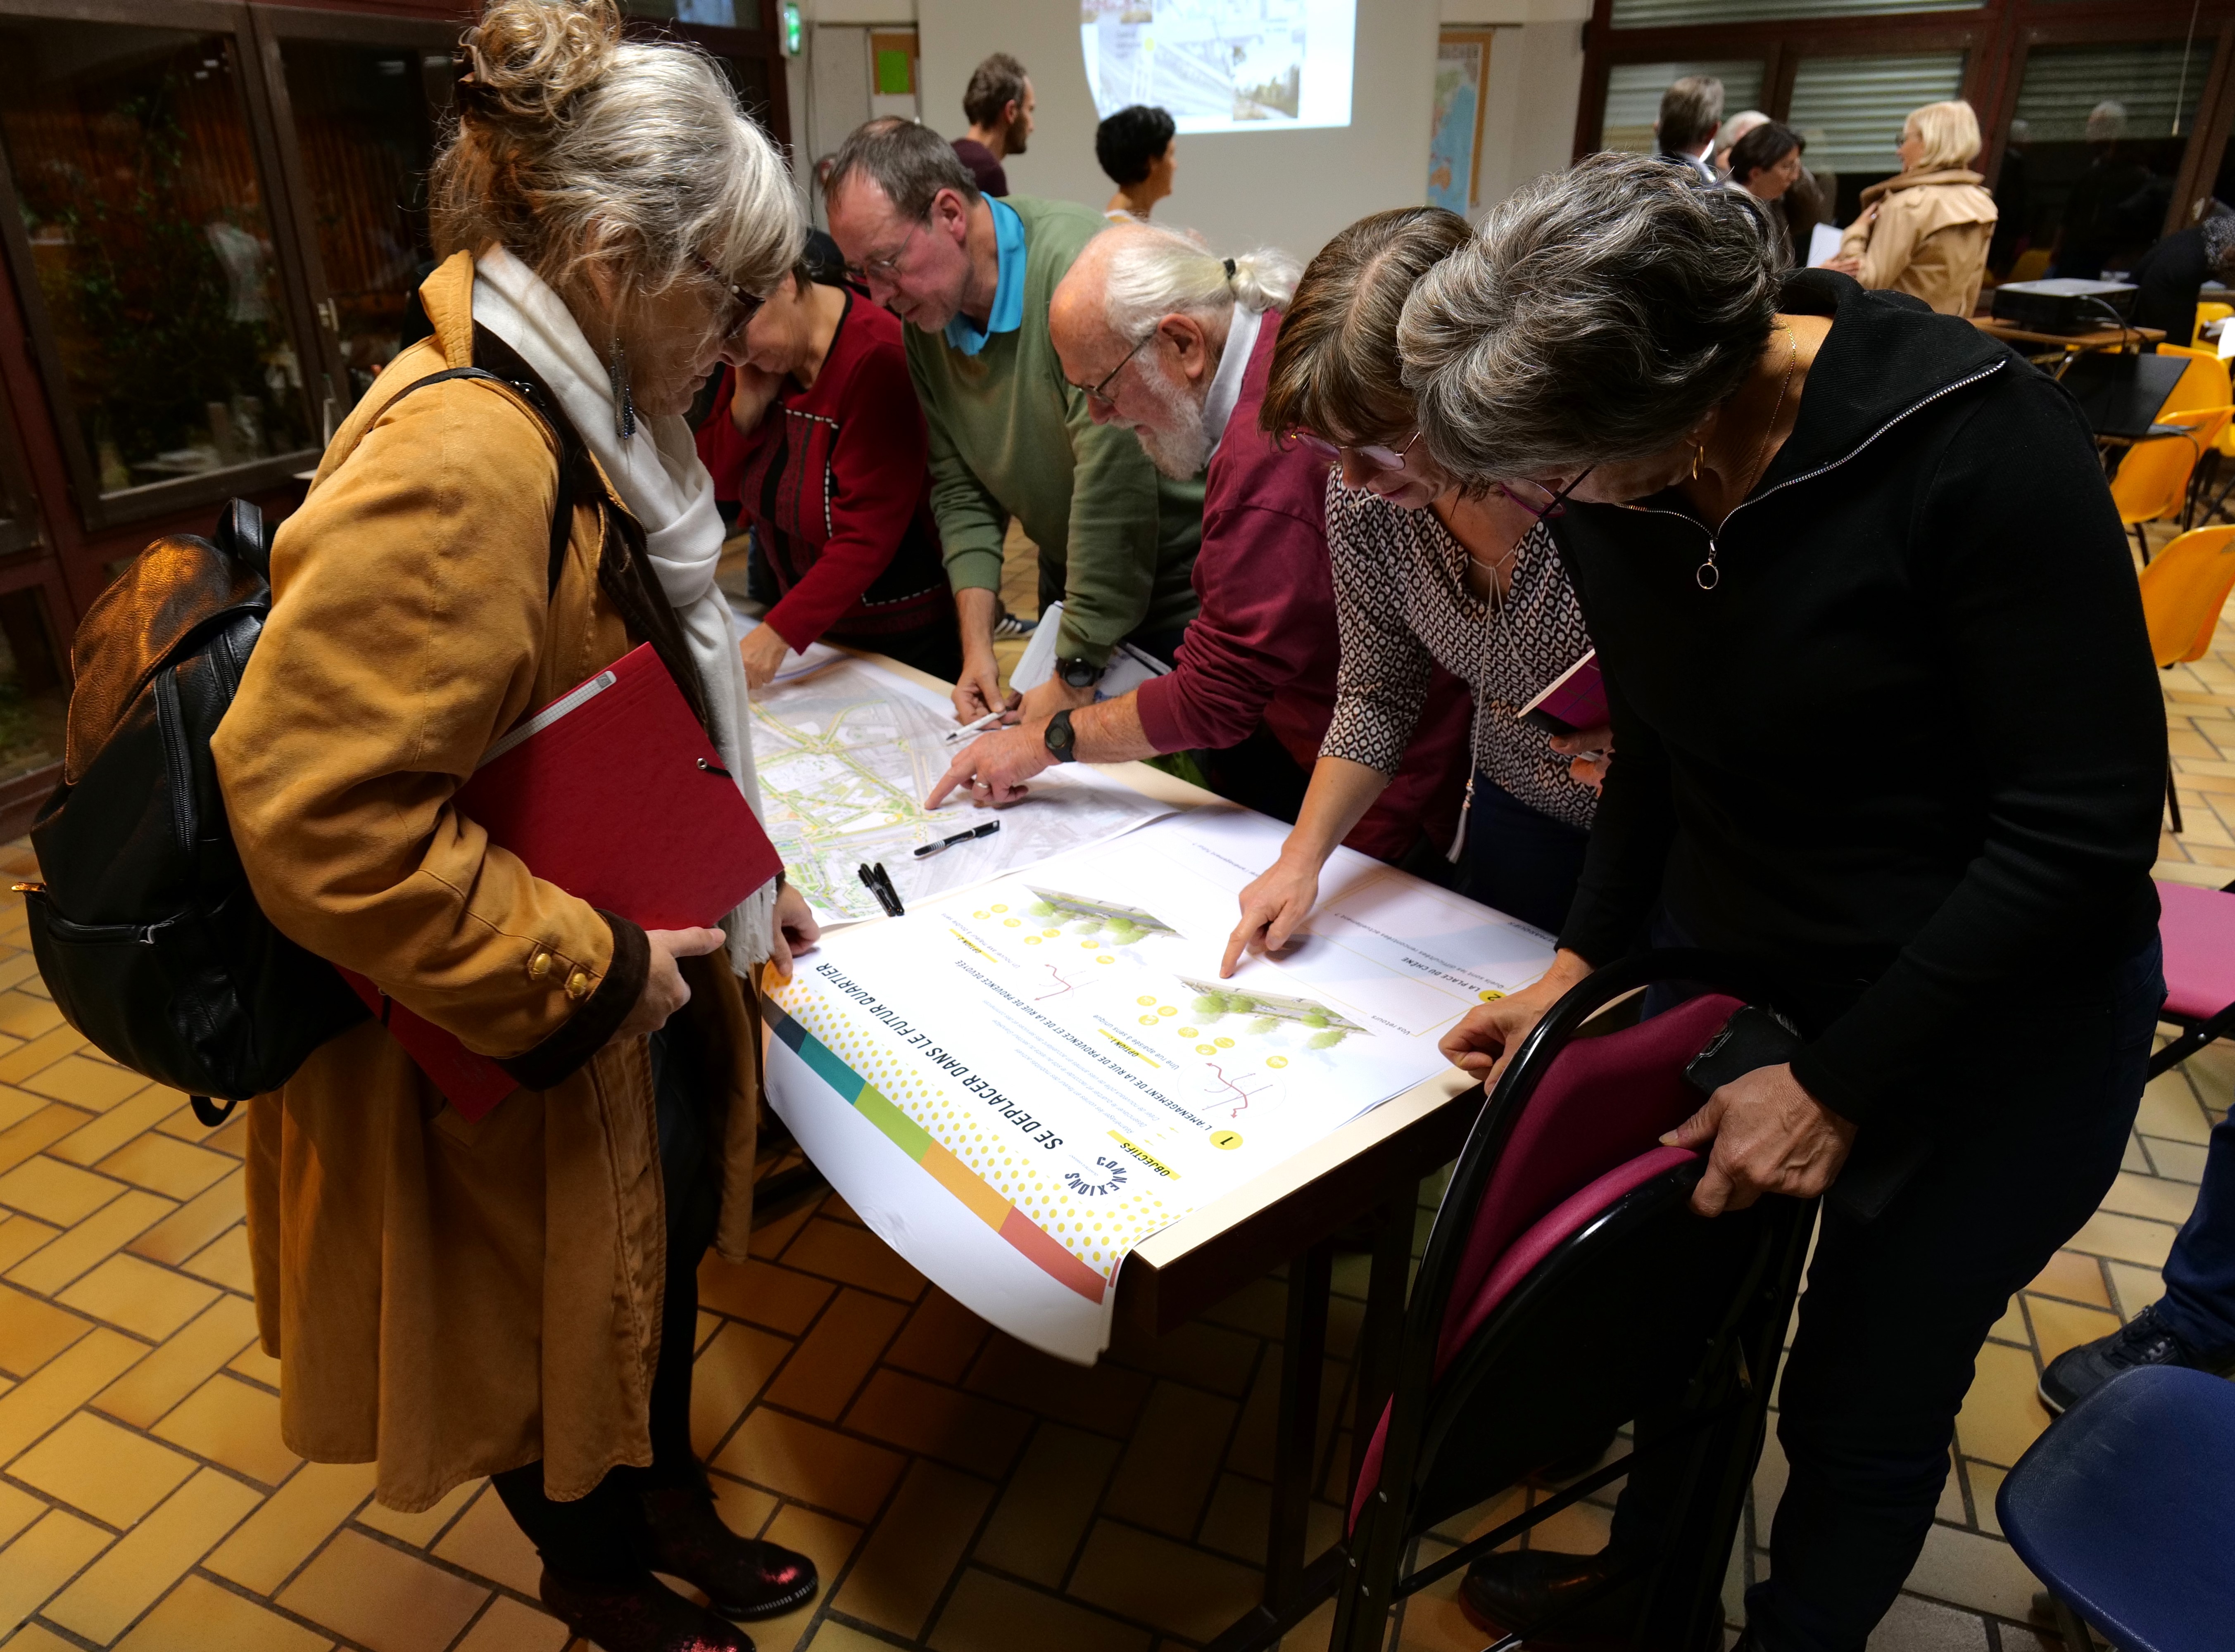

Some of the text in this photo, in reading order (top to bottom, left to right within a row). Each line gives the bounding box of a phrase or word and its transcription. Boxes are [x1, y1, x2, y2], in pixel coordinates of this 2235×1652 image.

[962, 940, 982, 953] OPTION
[1441, 974, 1469, 987] PLACE
[981, 978, 1015, 1000] PROVENCE
[1021, 1005, 1037, 1015] RUE
[1093, 1015, 1113, 1028] unique
[1371, 1016, 1410, 1035] Vos retours
[1113, 1028, 1127, 1036] sens
[1062, 1033, 1101, 1058] PROVENCE
[1114, 1042, 1139, 1056] OPTION
[1132, 1039, 1156, 1054] apaisée
[816, 963, 1063, 1149] SE DEPLACER DANS LE FUTUR QUARTIER
[1097, 1056, 1111, 1065] DE
[1108, 1063, 1126, 1075] RUE
[1166, 1061, 1179, 1070] Une
[1134, 1080, 1148, 1089] DE
[1144, 1088, 1212, 1130] L'AMENAGEMENT
[1220, 1136, 1234, 1146] 1
[1120, 1143, 1170, 1176] OBJECTIFS
[1065, 1156, 1127, 1196] CONNEXIONS
